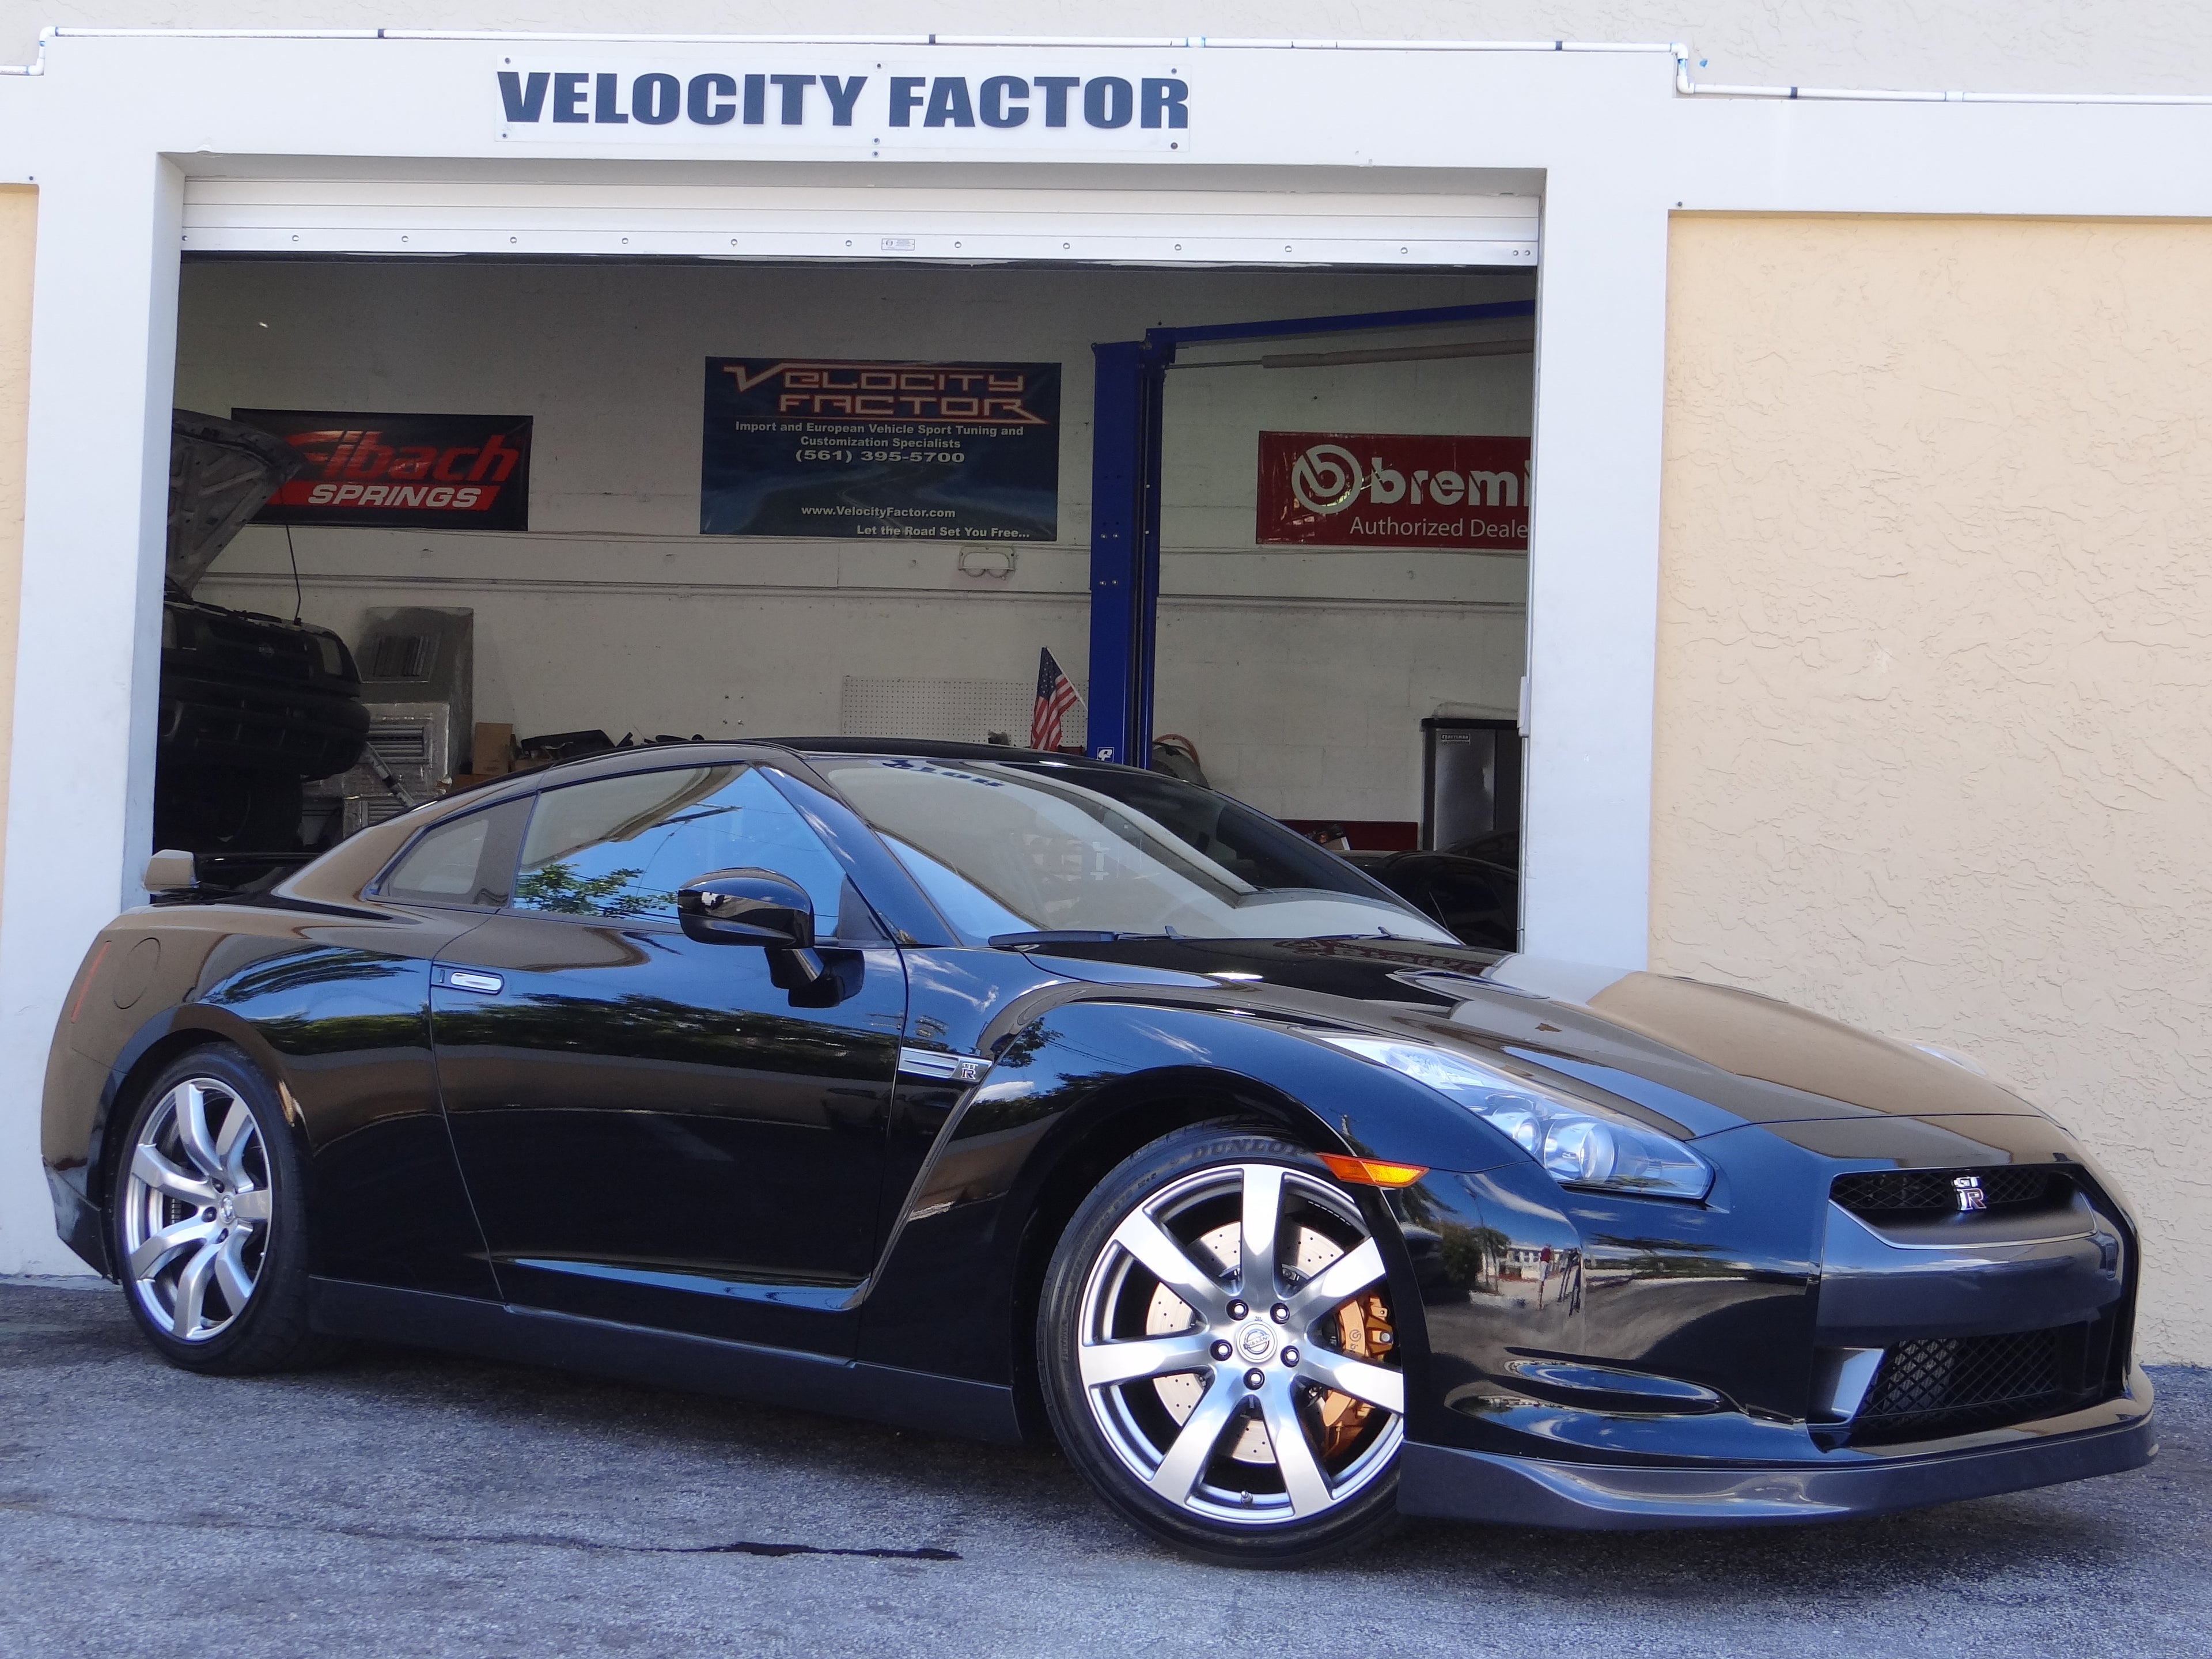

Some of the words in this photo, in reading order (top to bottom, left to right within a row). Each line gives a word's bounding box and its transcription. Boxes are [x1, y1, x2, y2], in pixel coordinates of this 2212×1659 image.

[498, 71, 868, 127] VELOCITY
[889, 75, 1189, 130] FACTOR
[779, 394, 1046, 424] FACTOR
[736, 421, 777, 433] Import
[780, 422, 802, 431] and
[806, 422, 864, 434] European
[869, 423, 914, 434] Vehicle
[918, 425, 952, 436] Sport
[956, 425, 997, 437] Tuning
[1001, 426, 1024, 436] and
[801, 436, 888, 447] Customization
[893, 438, 961, 449] Specialists
[796, 449, 853, 463] (561)
[861, 450, 965, 463] 395-5700
[1370, 457, 1530, 507] brem
[308, 484, 482, 508] SPRINGS
[801, 506, 956, 518] www.VelocityFactor.com
[857, 525, 877, 535] Let
[881, 526, 901, 536] the
[904, 526, 935, 536] Road
[940, 527, 961, 537] Set
[964, 528, 987, 537] You
[991, 528, 1030, 538] Free...
[1350, 516, 1463, 537] Authorized
